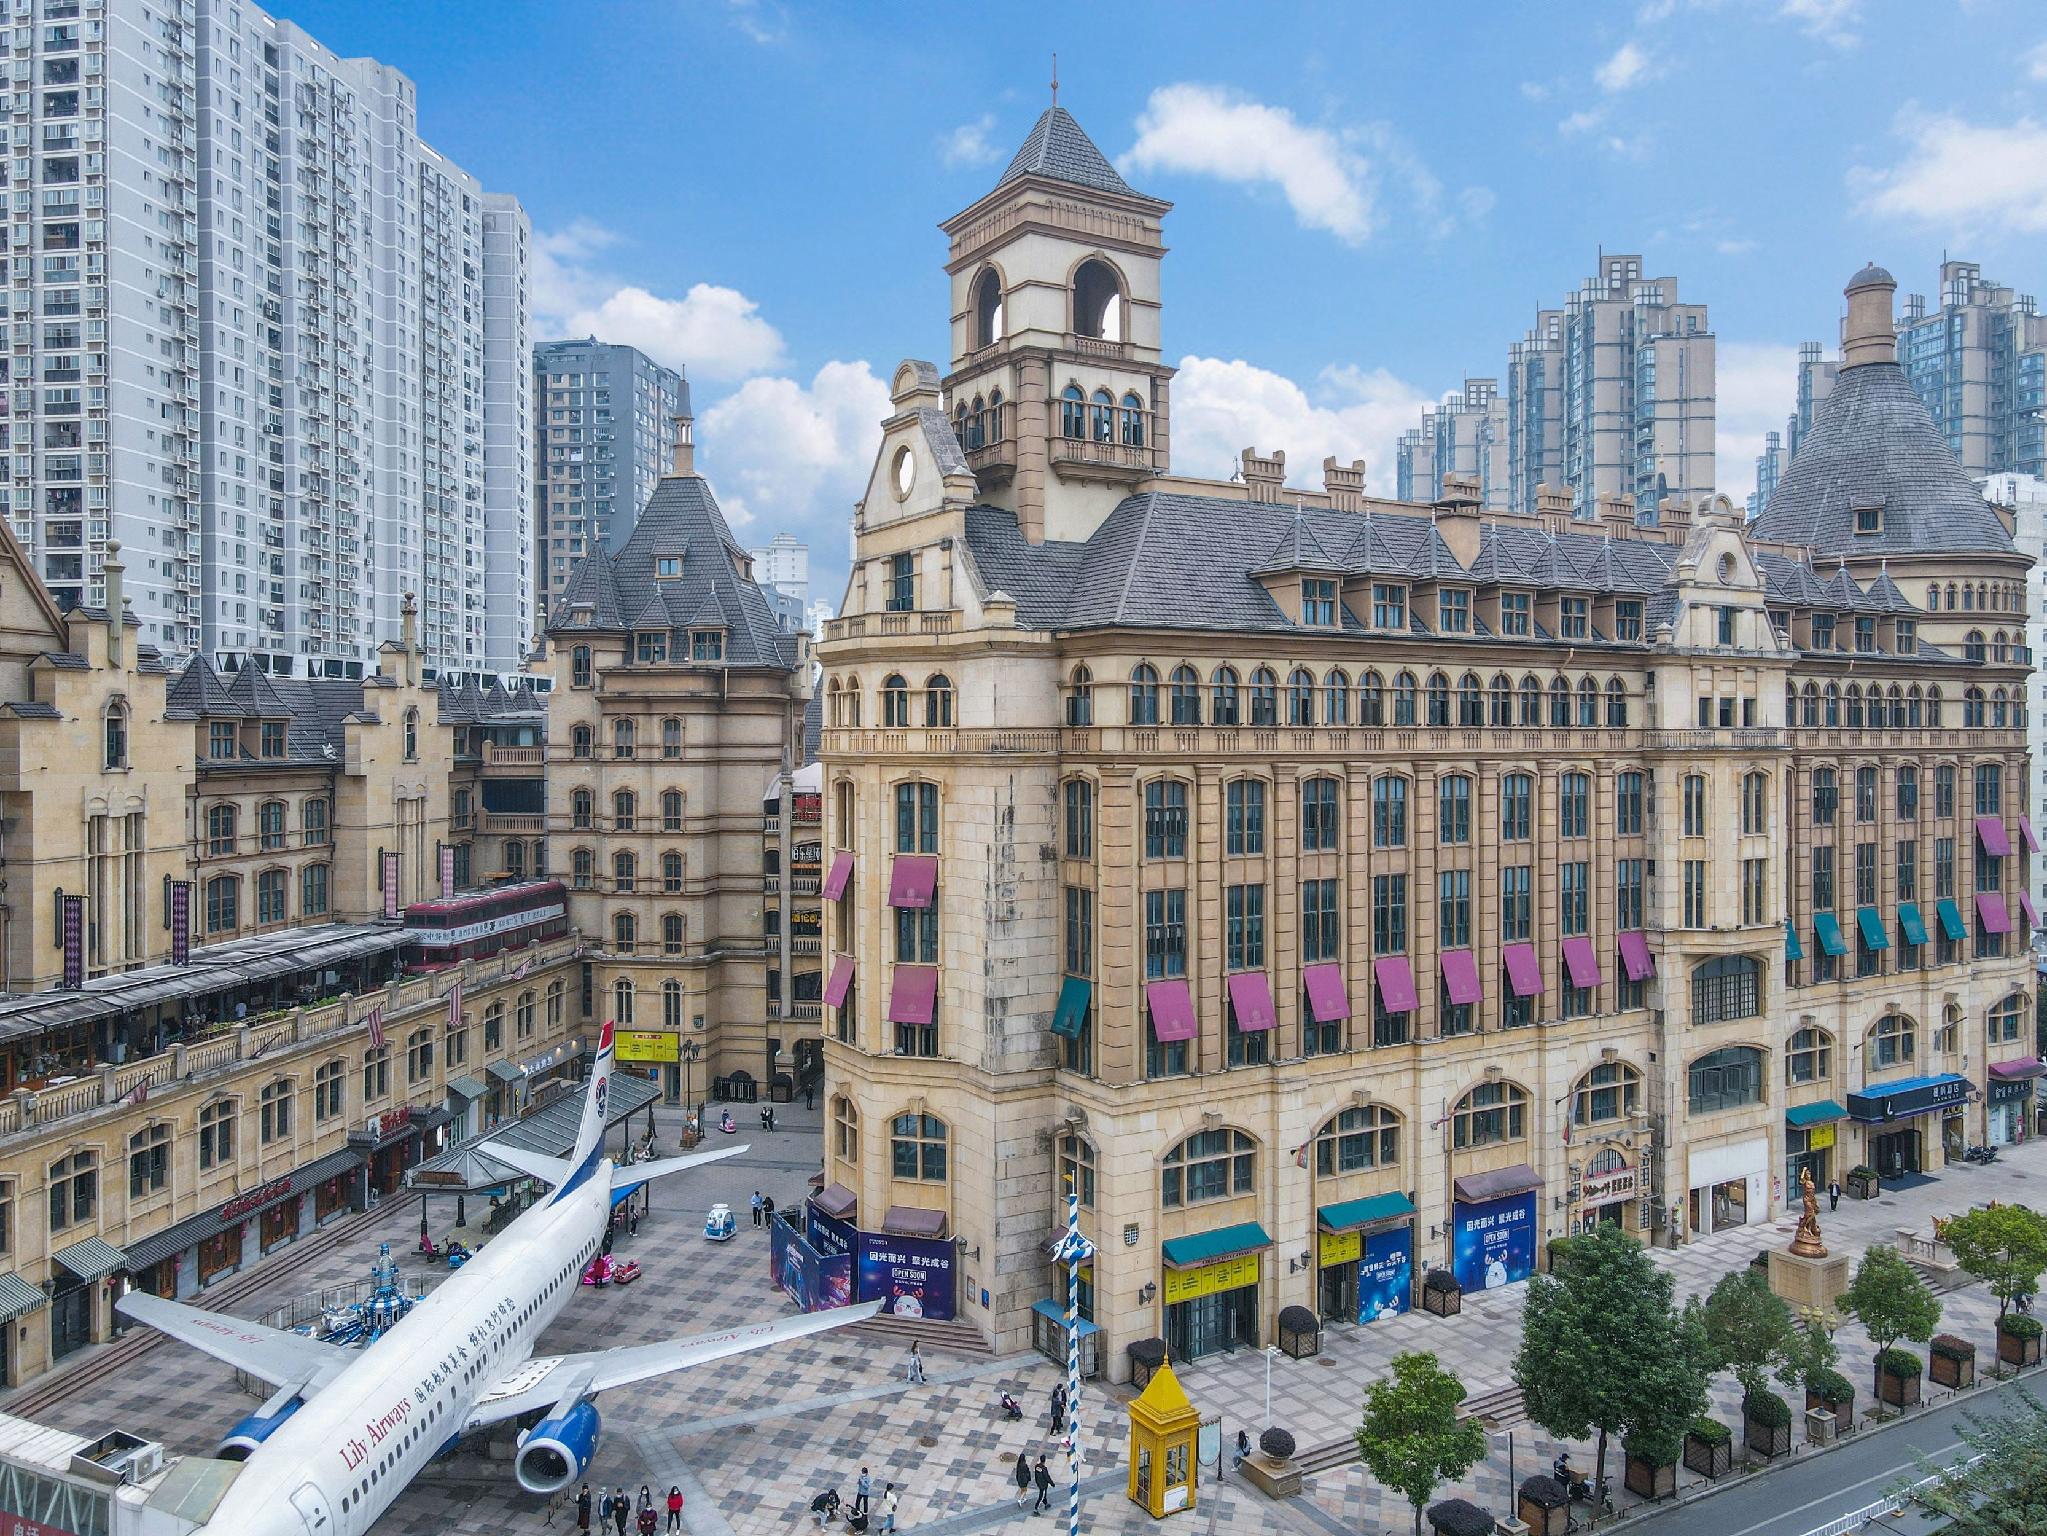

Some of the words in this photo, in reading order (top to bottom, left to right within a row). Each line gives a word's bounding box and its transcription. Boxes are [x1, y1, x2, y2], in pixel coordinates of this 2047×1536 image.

[869, 1251, 906, 1264] 因光而兴
[911, 1255, 949, 1269] 聚光成谷
[894, 1268, 909, 1278] OPEN
[909, 1270, 925, 1280] SOON
[339, 1438, 369, 1472] Lily
[366, 1397, 412, 1448] Airways
